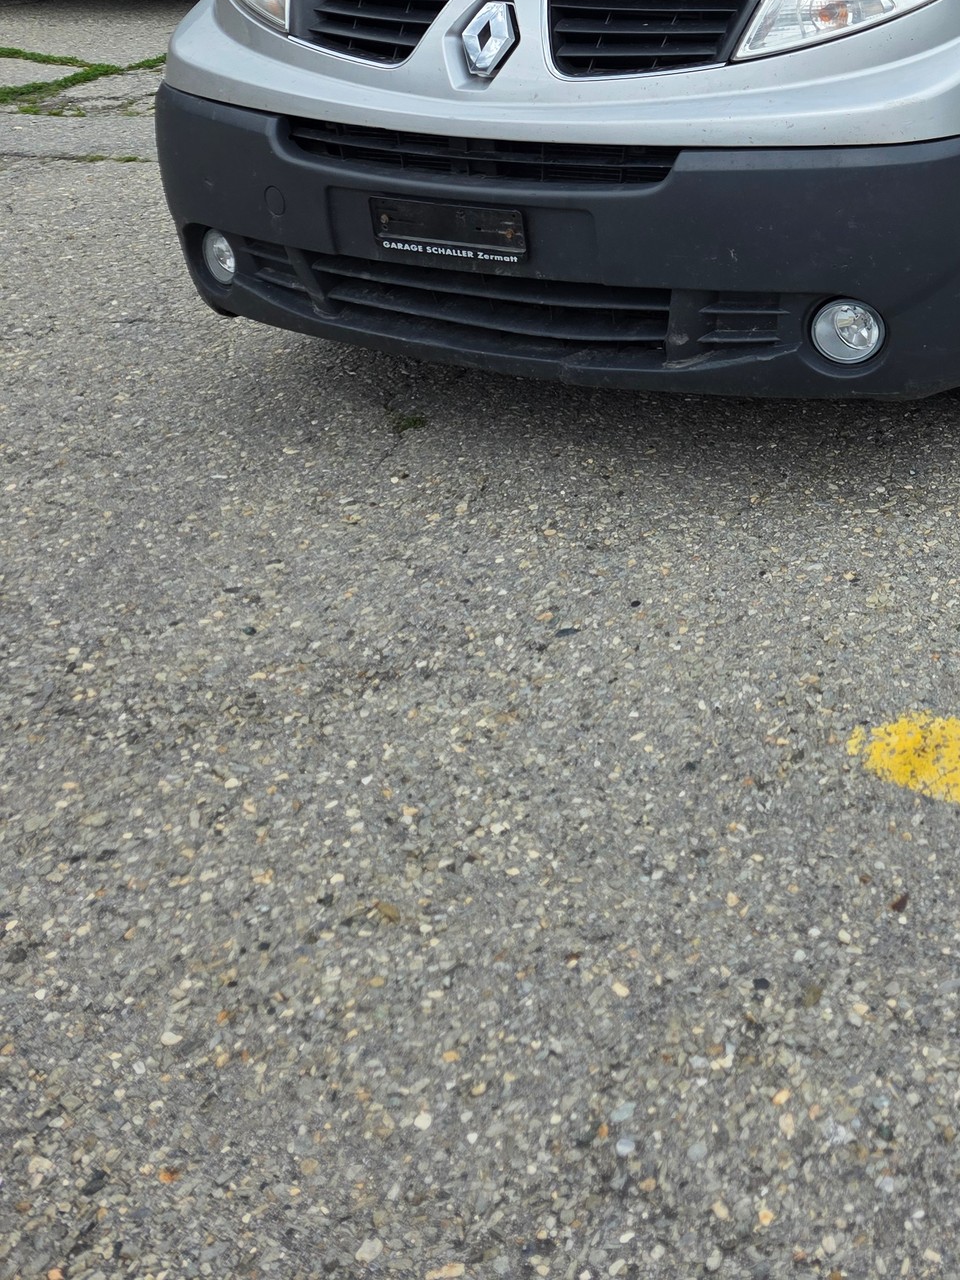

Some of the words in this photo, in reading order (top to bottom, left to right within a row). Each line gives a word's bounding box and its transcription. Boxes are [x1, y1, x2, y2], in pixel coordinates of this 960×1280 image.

[382, 240, 424, 253] GARAGE
[426, 246, 475, 259] SCHALLER
[477, 251, 519, 263] Zermatt
